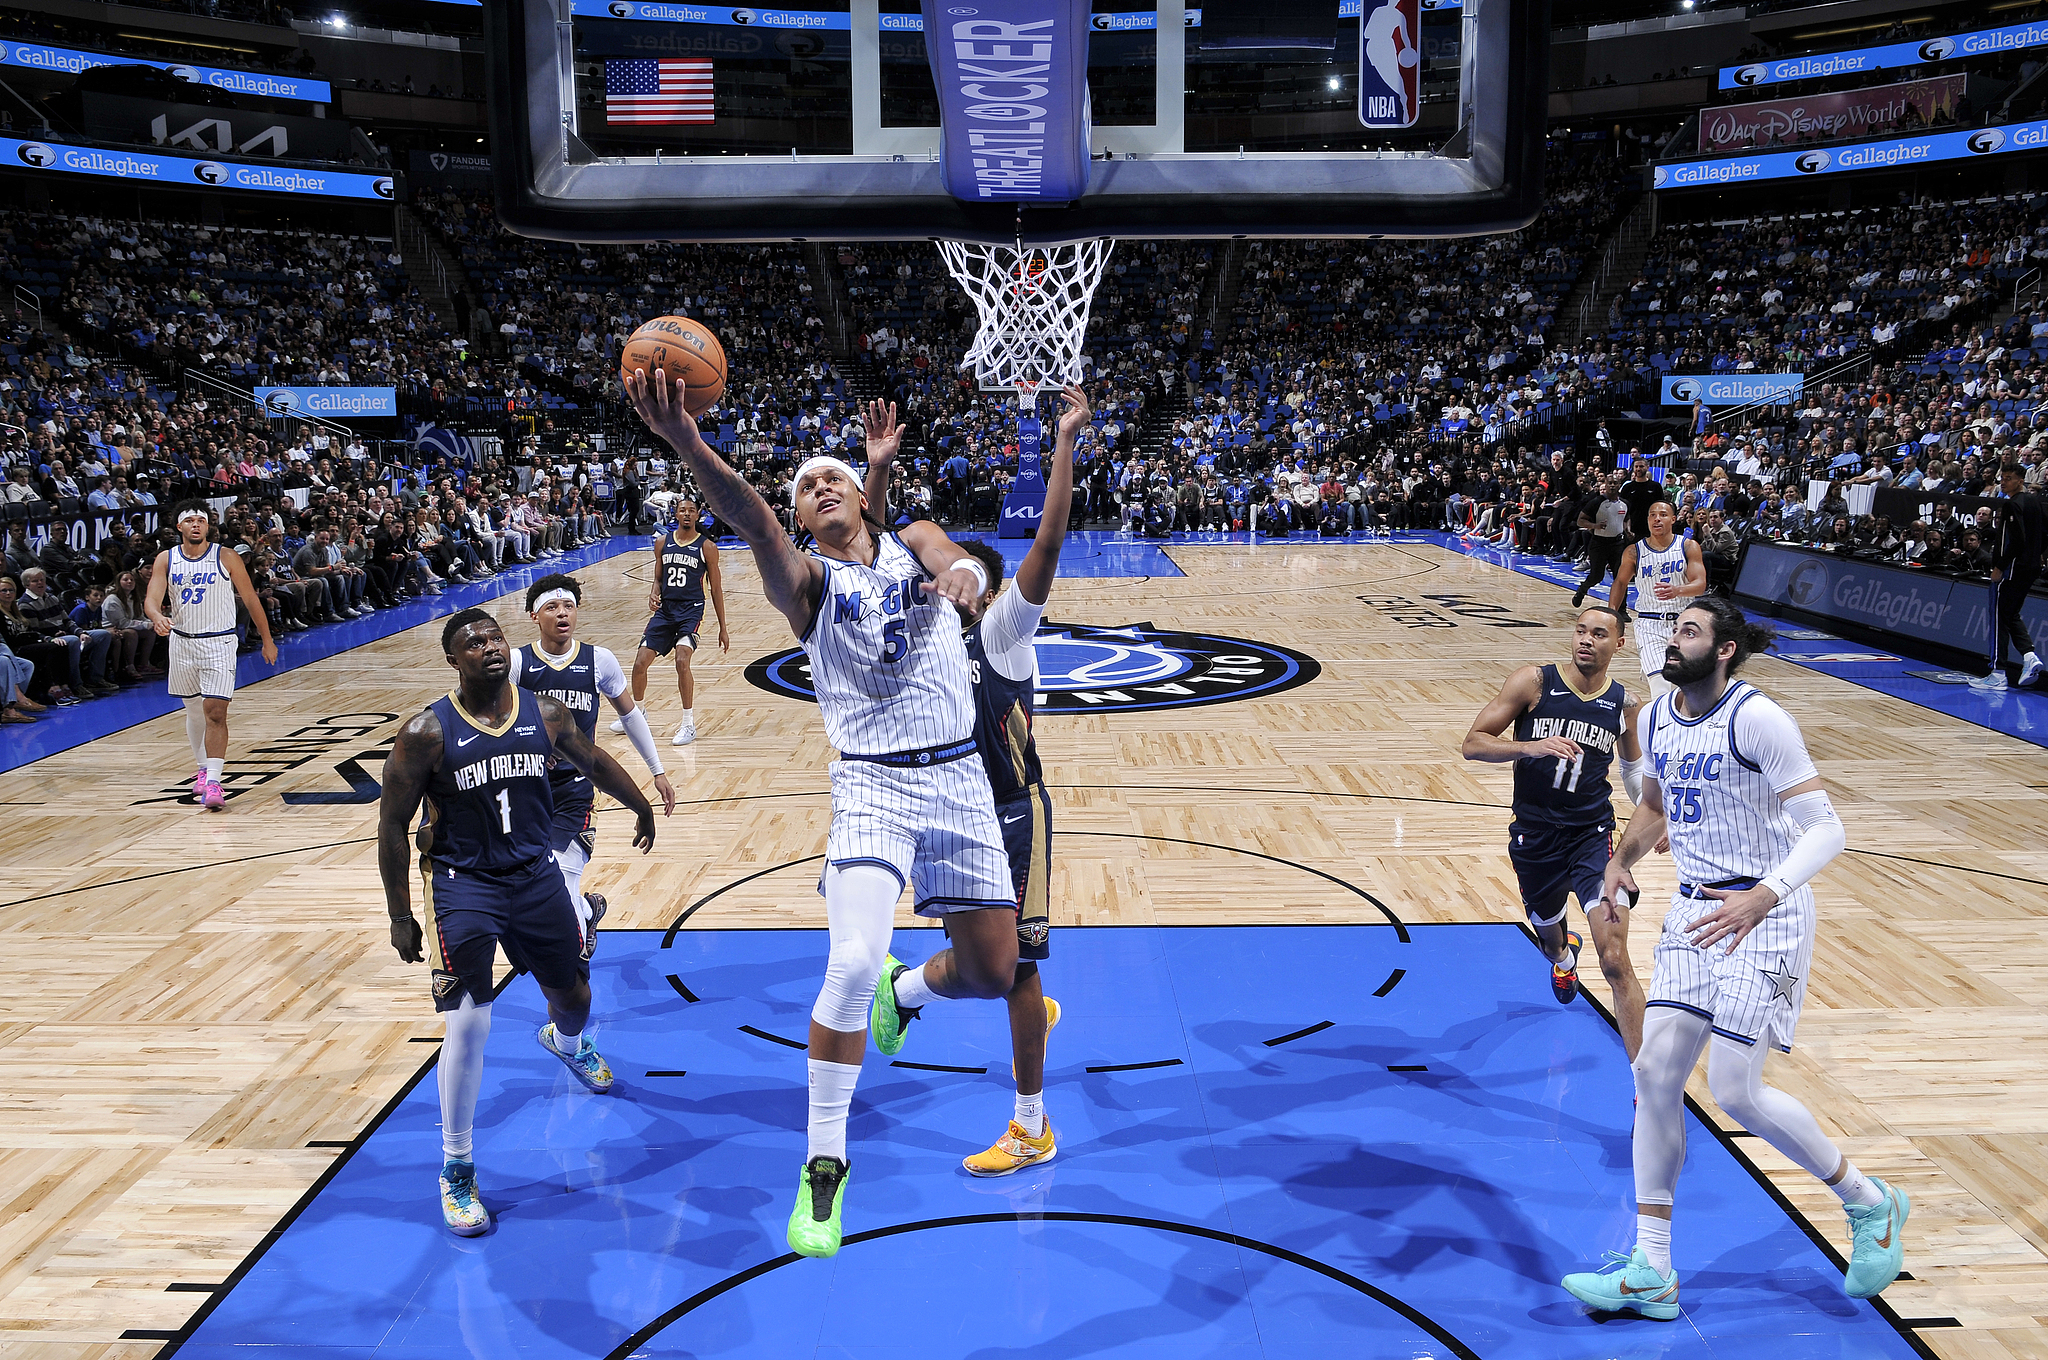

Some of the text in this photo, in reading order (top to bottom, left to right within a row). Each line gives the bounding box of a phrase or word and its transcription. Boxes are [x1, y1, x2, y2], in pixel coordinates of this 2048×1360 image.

[640, 5, 707, 22] Gallagher
[762, 13, 827, 28] Gallagher
[1775, 55, 1866, 78] Gallagher
[208, 72, 298, 96] Gallagher
[952, 19, 1054, 197] THREATLOCKER
[1368, 96, 1397, 119] NBA
[1848, 99, 1906, 126] World
[64, 150, 160, 177] Gallagher
[236, 168, 326, 192] Gallagher
[451, 156, 491, 166] FANDUEL
[1674, 161, 1761, 183] Gallagher
[1838, 142, 1931, 167] Gallagher
[641, 320, 706, 352] Wilson
[307, 393, 388, 413] Gallagher
[1708, 381, 1796, 400] Gallagher
[673, 553, 699, 569] ORLEANS
[667, 566, 687, 588] 25
[181, 588, 206, 605] 93
[1355, 594, 1459, 628] CENTER
[1833, 575, 1951, 631] Gallagher
[883, 619, 909, 664] 5
[1532, 718, 1616, 754] NEW ORLEANS
[1706, 720, 1727, 730] Disney
[128, 712, 399, 806] CENTER
[453, 754, 545, 791] NEW ORLEANS
[1552, 753, 1585, 793] 11
[495, 787, 512, 835] 1
[1669, 787, 1702, 824] 35
